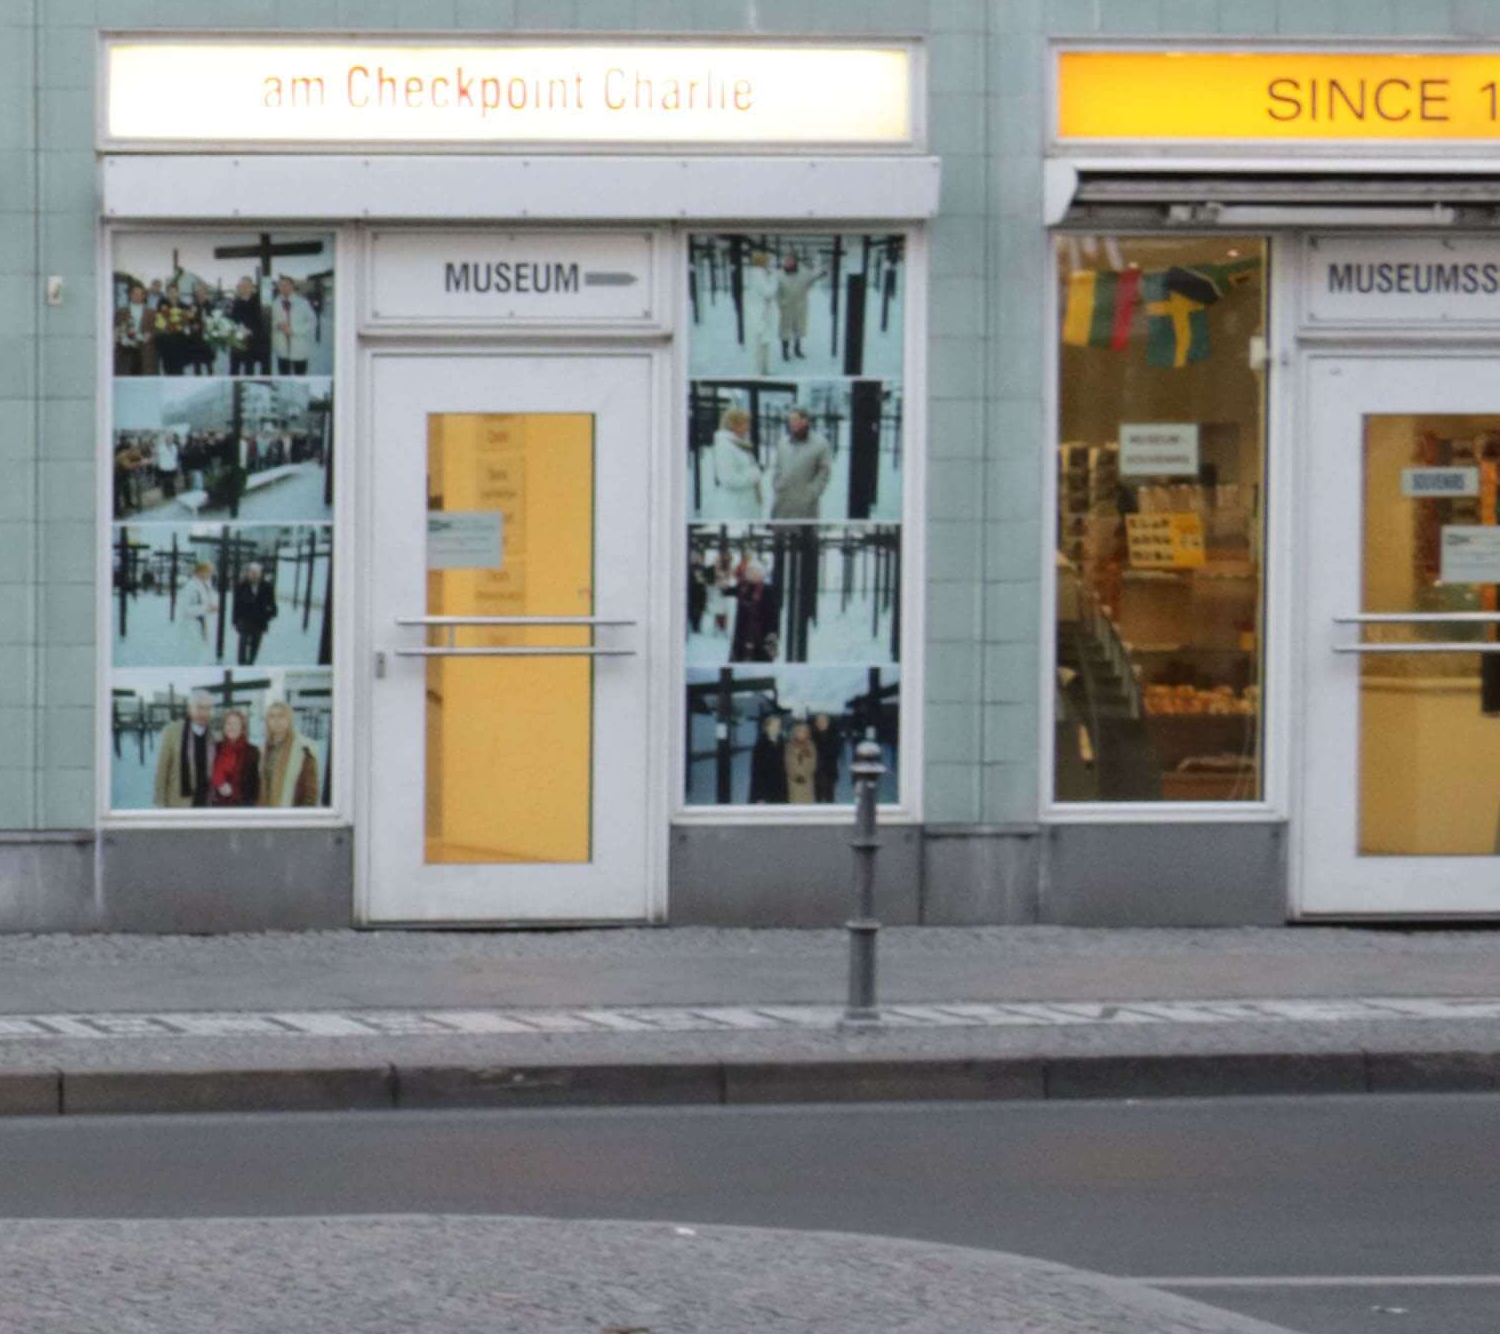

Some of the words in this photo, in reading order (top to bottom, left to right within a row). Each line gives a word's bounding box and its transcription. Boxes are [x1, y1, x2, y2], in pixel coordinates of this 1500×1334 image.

[261, 74, 325, 108] am
[346, 65, 585, 118] Checkpoint
[604, 67, 755, 111] Charlie
[1267, 77, 1451, 123] SINCE
[445, 262, 580, 294] MUSEUM
[1328, 263, 1499, 294] MUSEUMSS
